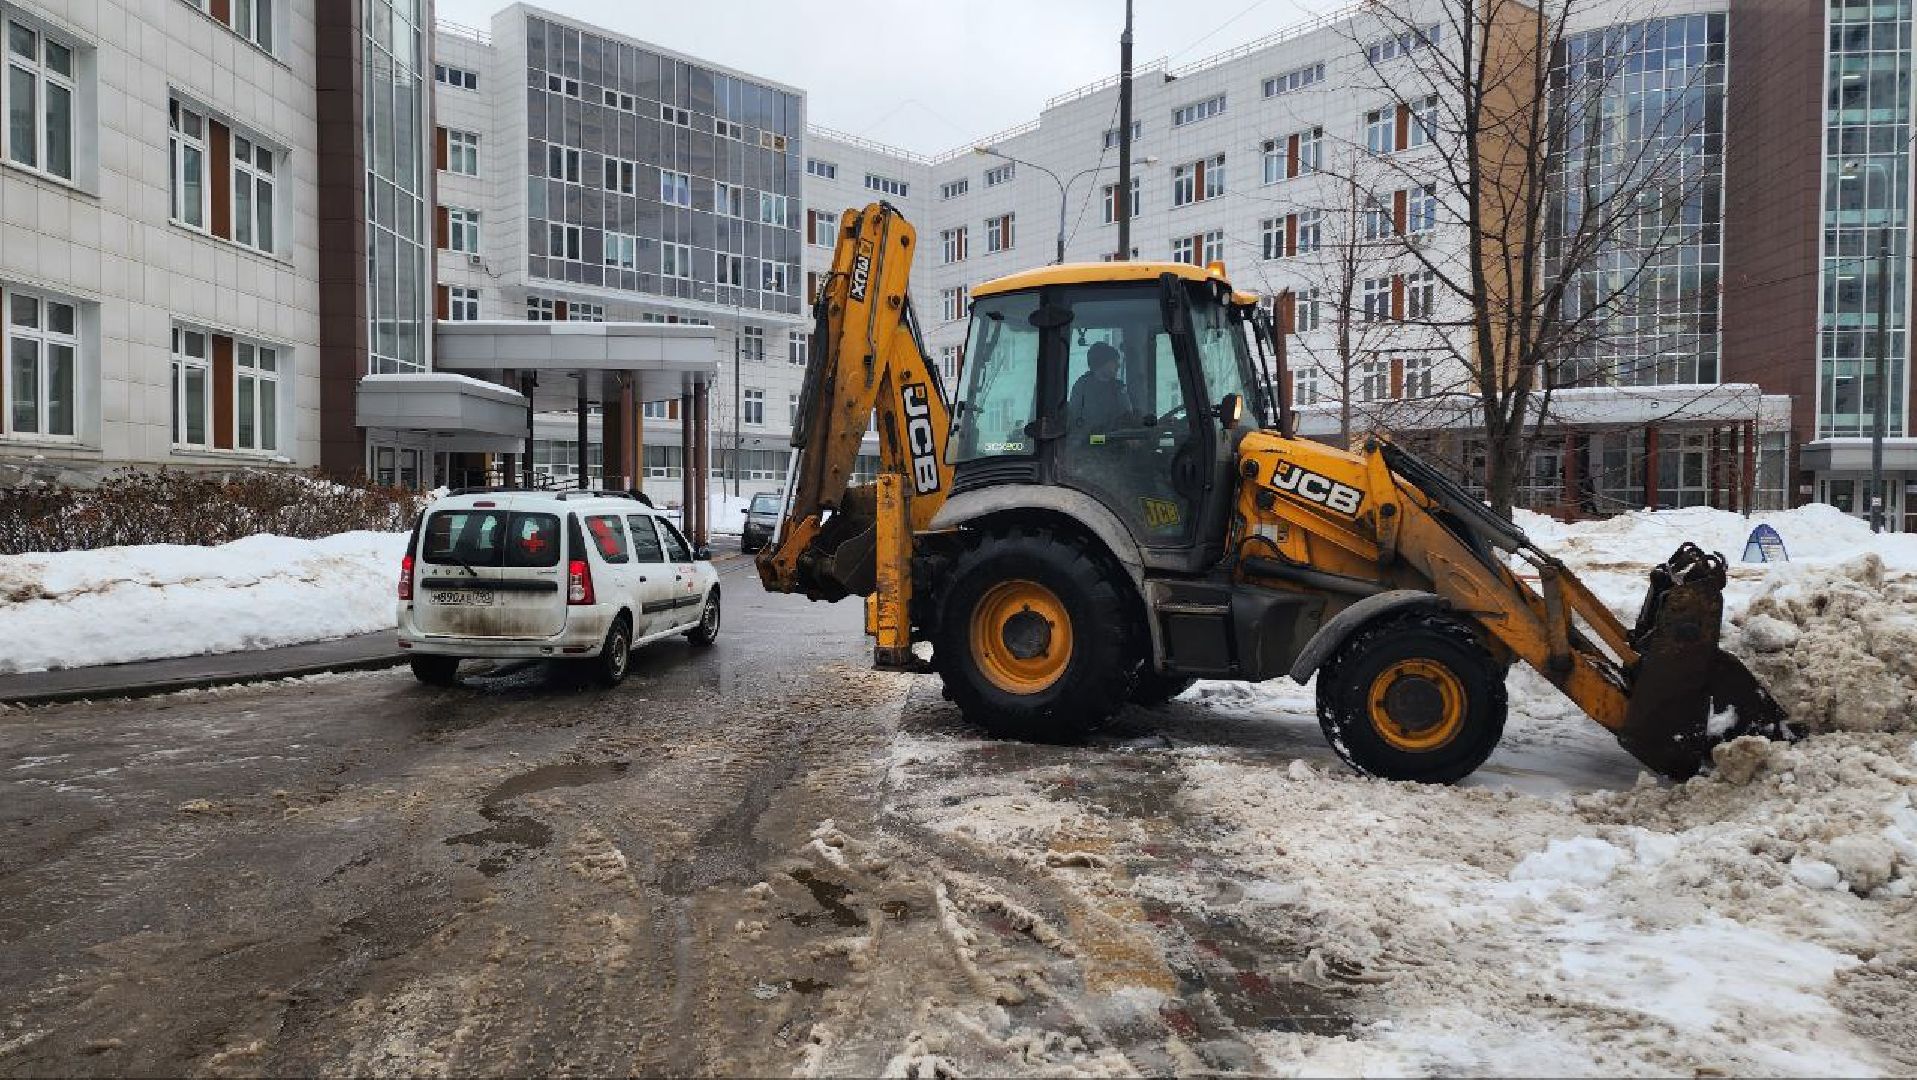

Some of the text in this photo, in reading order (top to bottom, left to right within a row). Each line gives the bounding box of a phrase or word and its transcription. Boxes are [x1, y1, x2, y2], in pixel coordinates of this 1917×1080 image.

[851, 256, 869, 297] 3CX
[903, 386, 938, 493] JCB
[1273, 466, 1360, 514] JCB
[1146, 501, 1178, 527] JCB
